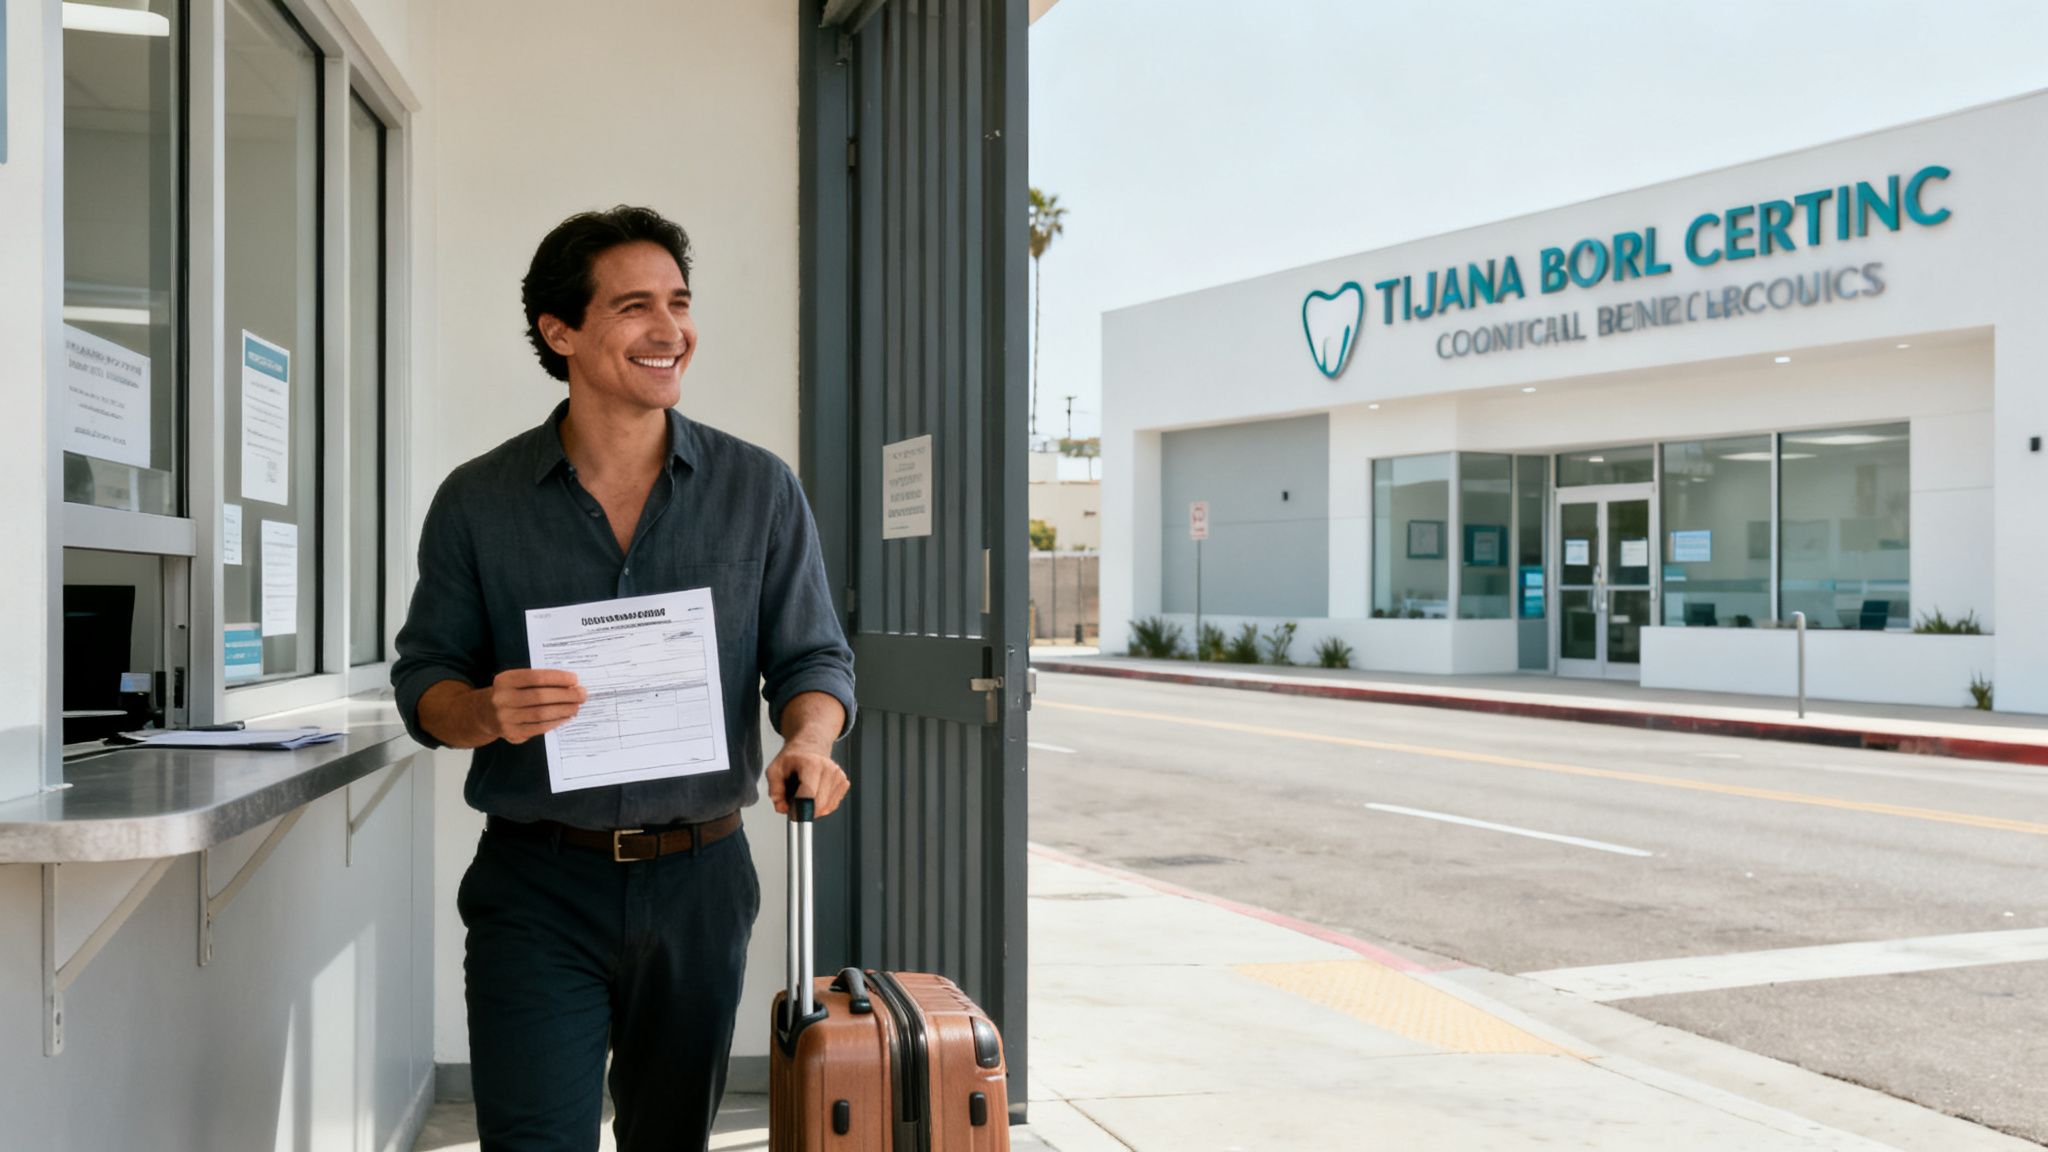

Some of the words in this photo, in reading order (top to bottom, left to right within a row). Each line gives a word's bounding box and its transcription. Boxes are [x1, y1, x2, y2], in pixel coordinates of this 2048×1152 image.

[1375, 255, 1526, 325] TIJANA
[1540, 227, 1672, 295] BORL
[1685, 165, 1952, 267] CERTINC
